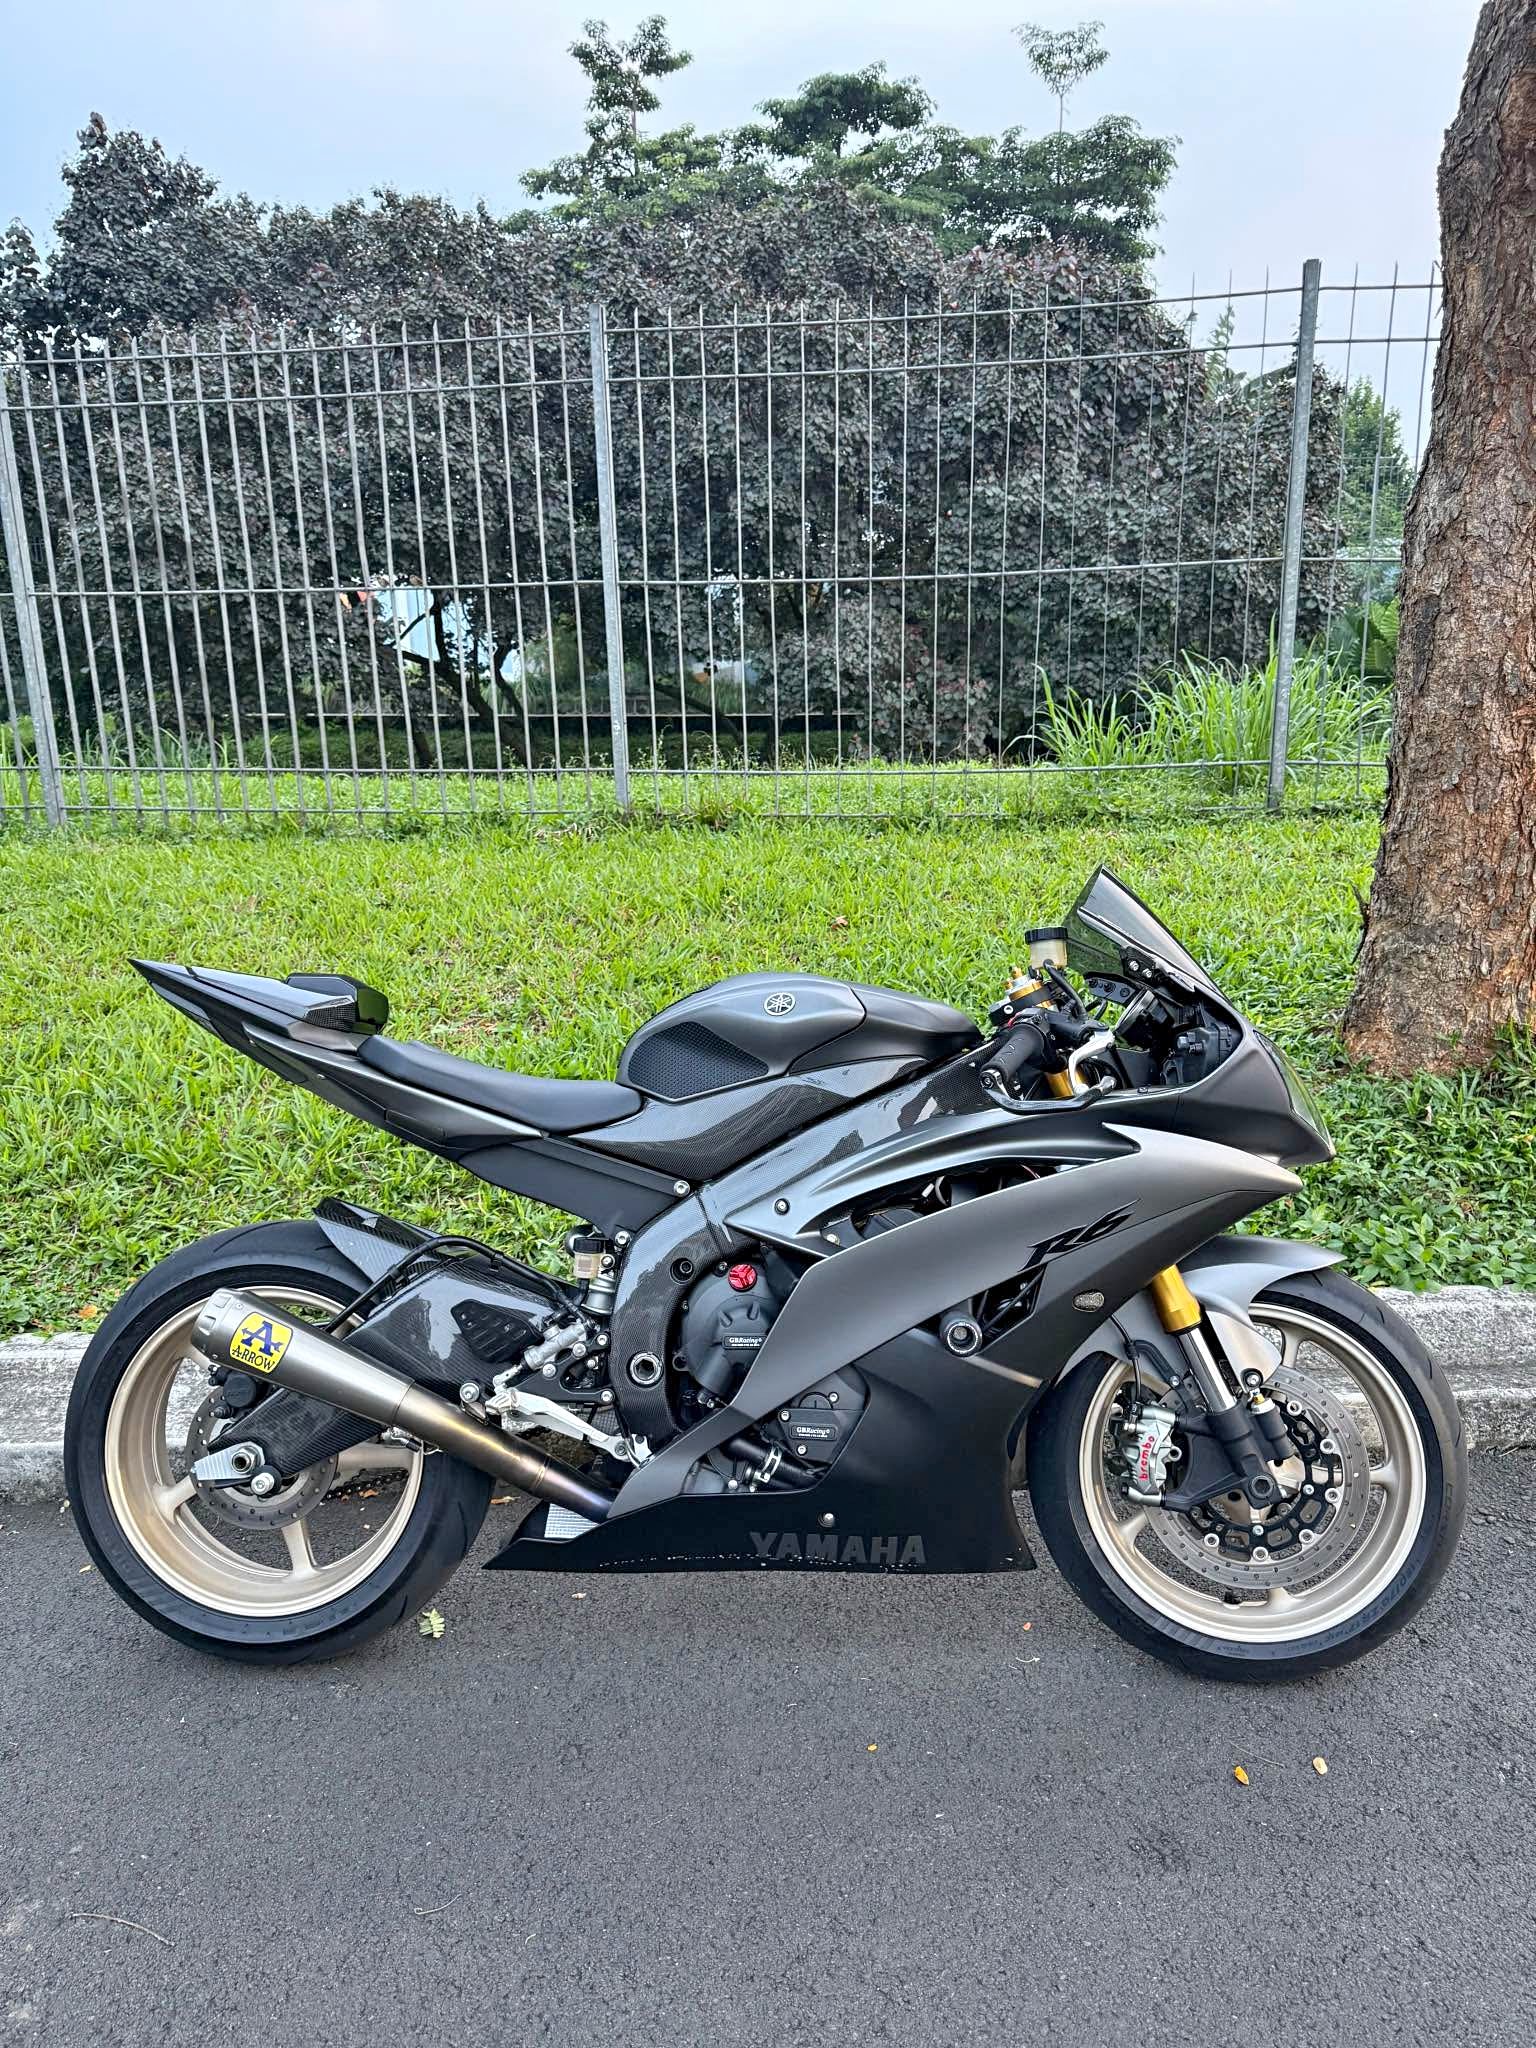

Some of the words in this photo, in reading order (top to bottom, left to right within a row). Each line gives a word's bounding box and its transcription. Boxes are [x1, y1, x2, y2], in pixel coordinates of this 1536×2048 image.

[1018, 1199, 1140, 1272] R6
[232, 1345, 275, 1371] ARROW
[1139, 1435, 1155, 1480] brembo
[749, 1532, 926, 1564] YAMAHA
